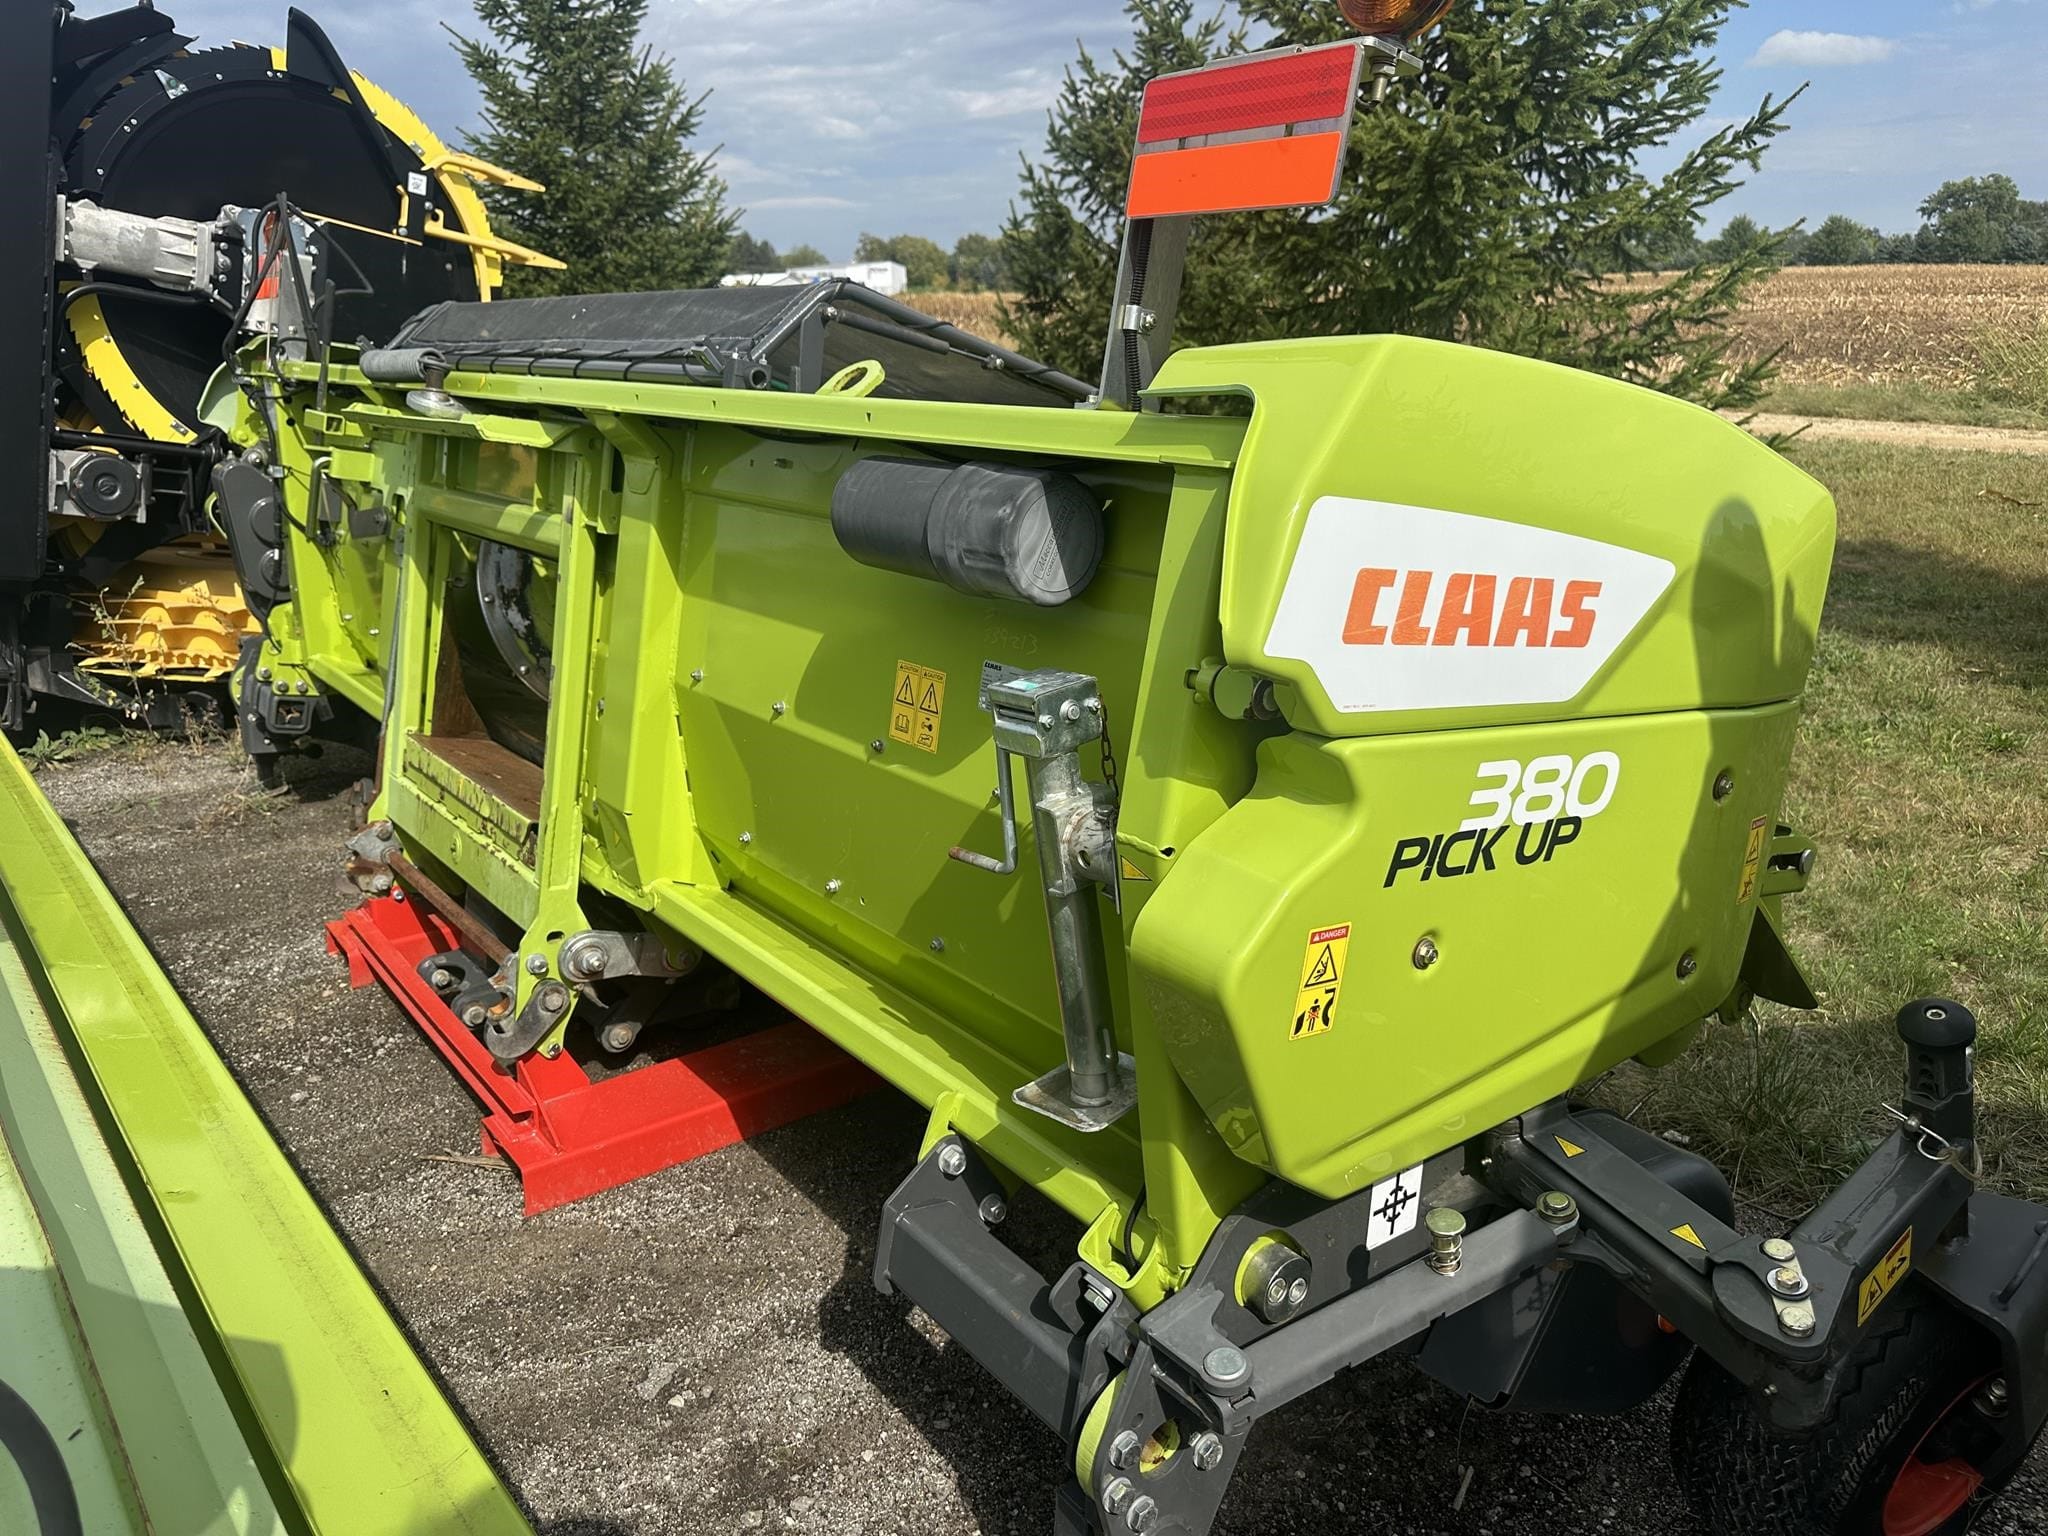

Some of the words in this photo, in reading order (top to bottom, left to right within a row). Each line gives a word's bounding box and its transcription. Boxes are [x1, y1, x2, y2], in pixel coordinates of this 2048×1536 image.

[1342, 567, 1603, 648] CLAAS
[928, 672, 943, 681] CAUTION
[1459, 751, 1620, 833] 380
[1383, 824, 1510, 889] PICK
[1515, 815, 1582, 865] UP
[1320, 928, 1347, 940] DANGER
